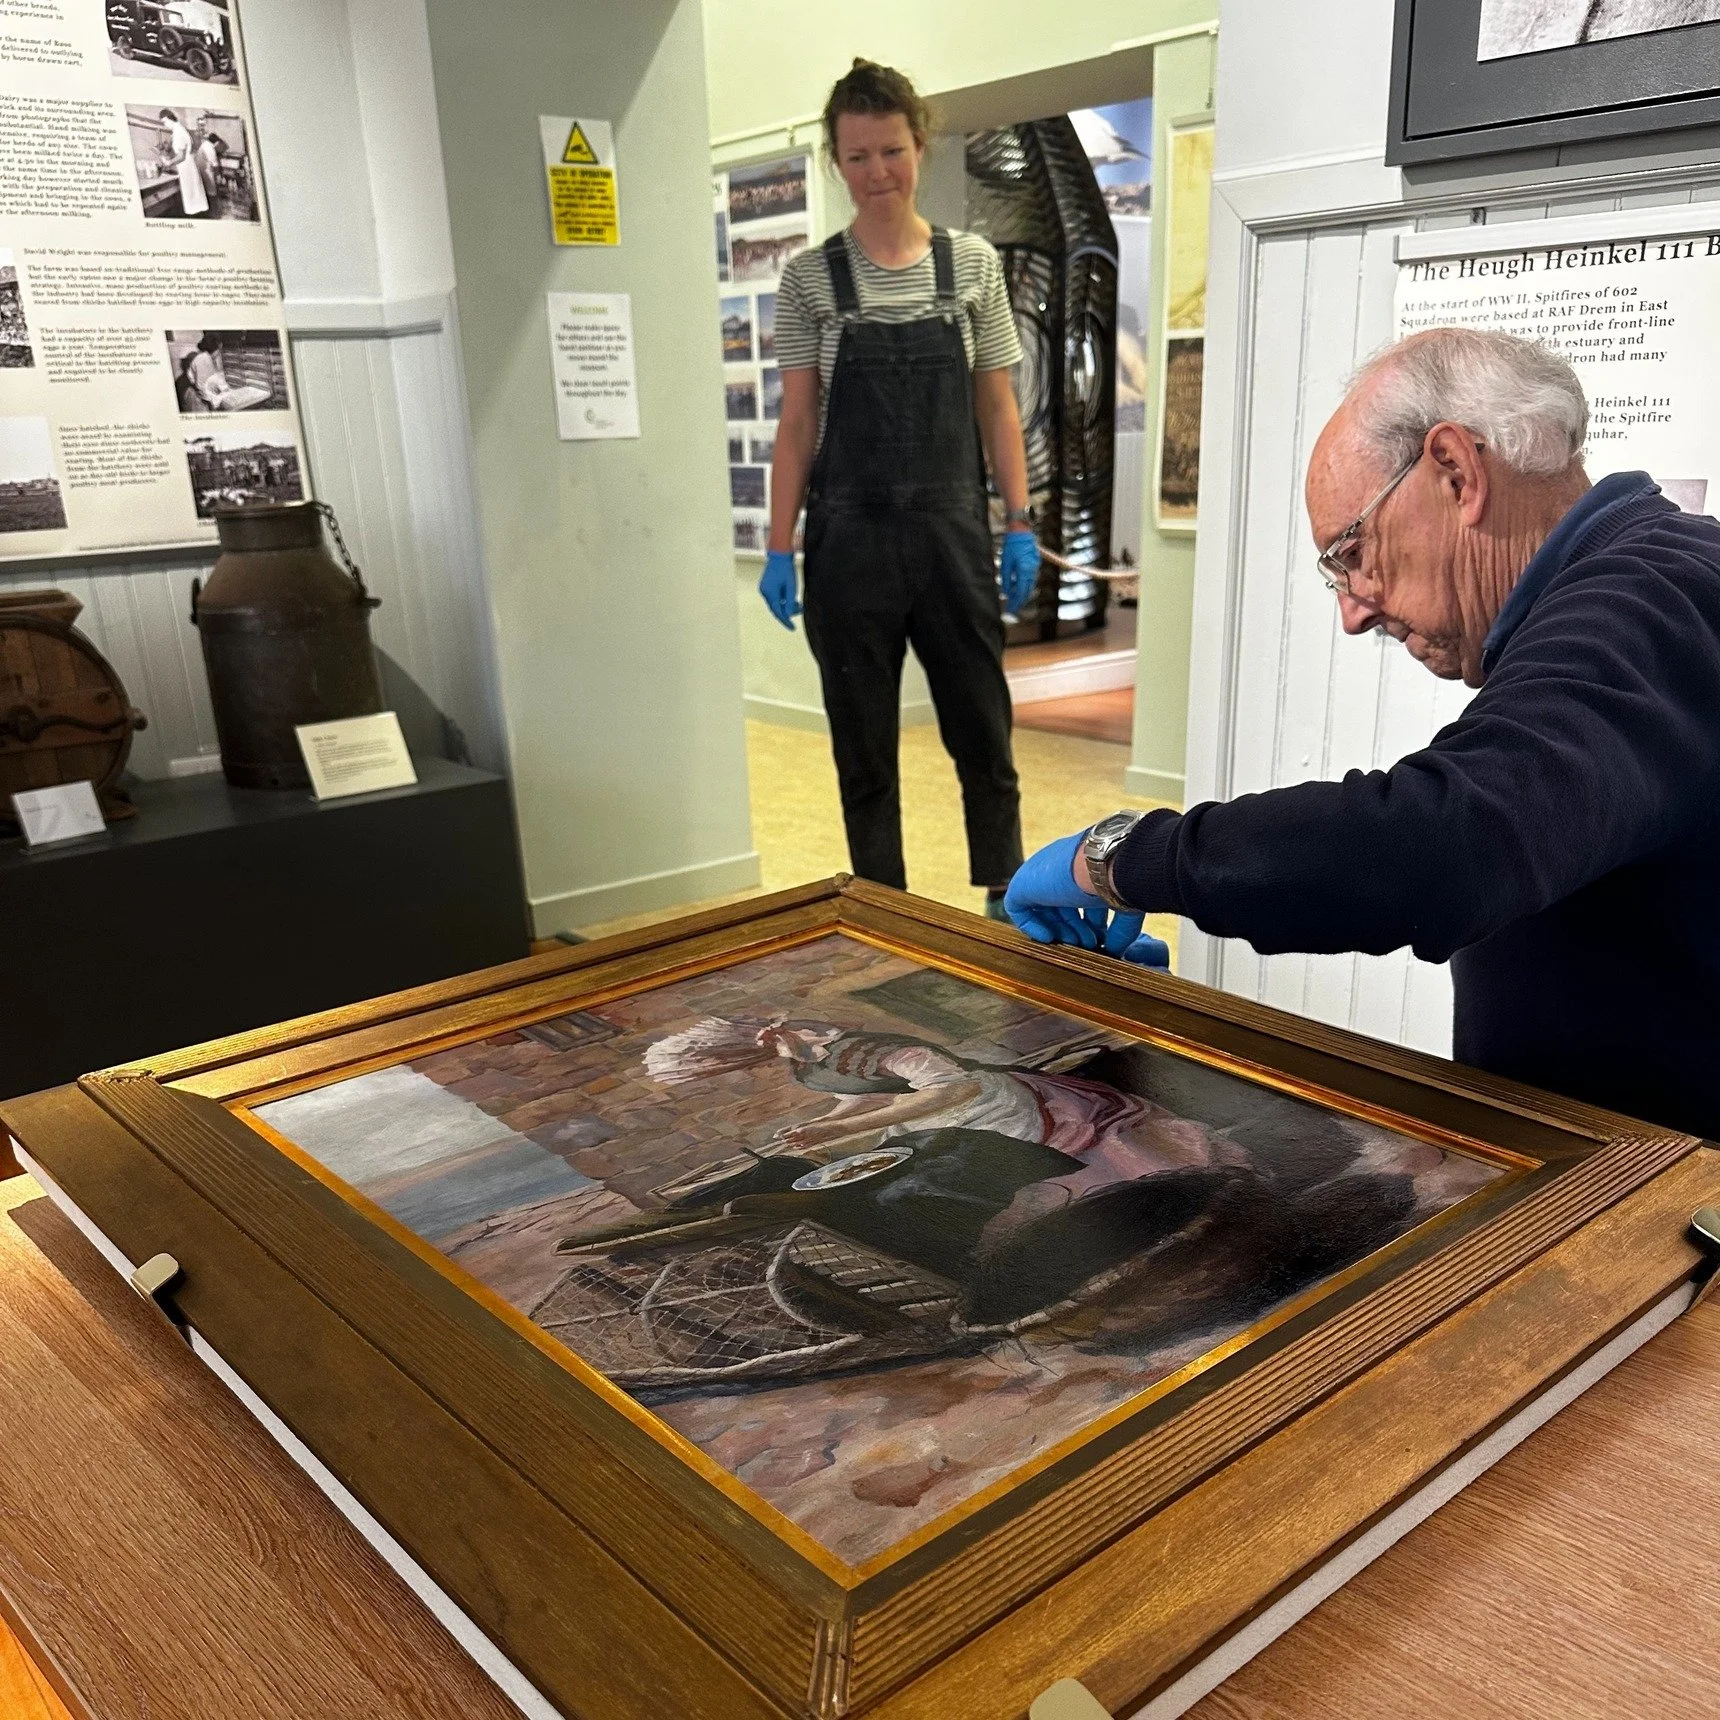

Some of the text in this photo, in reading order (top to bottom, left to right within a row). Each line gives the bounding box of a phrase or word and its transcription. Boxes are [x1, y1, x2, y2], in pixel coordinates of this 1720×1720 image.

[1411, 262, 1449, 282] The
[1458, 252, 1534, 279] Heugh
[1544, 240, 1648, 270] Heinkel
[1656, 241, 1694, 260] 111
[1402, 302, 1414, 312] At
[1418, 300, 1437, 312] the
[1440, 298, 1468, 310] start
[1472, 297, 1486, 308] of
[1488, 294, 1514, 306] WW
[1534, 289, 1590, 305] Spitfires
[1595, 286, 1610, 298] of
[1612, 287, 1638, 297] 602
[1400, 300, 1668, 329] Squadron were based at RAF Drem in East
[1510, 327, 1532, 335] was
[1537, 324, 1548, 334] to
[1552, 320, 1604, 335] provide
[1608, 316, 1675, 330] front-line
[1565, 336, 1614, 348] estuary
[1619, 333, 1644, 345] and
[1600, 350, 1626, 362] had
[1629, 350, 1667, 362] many
[1595, 396, 1670, 407] Heinkel 111
[1595, 411, 1672, 425] the Spitfire
